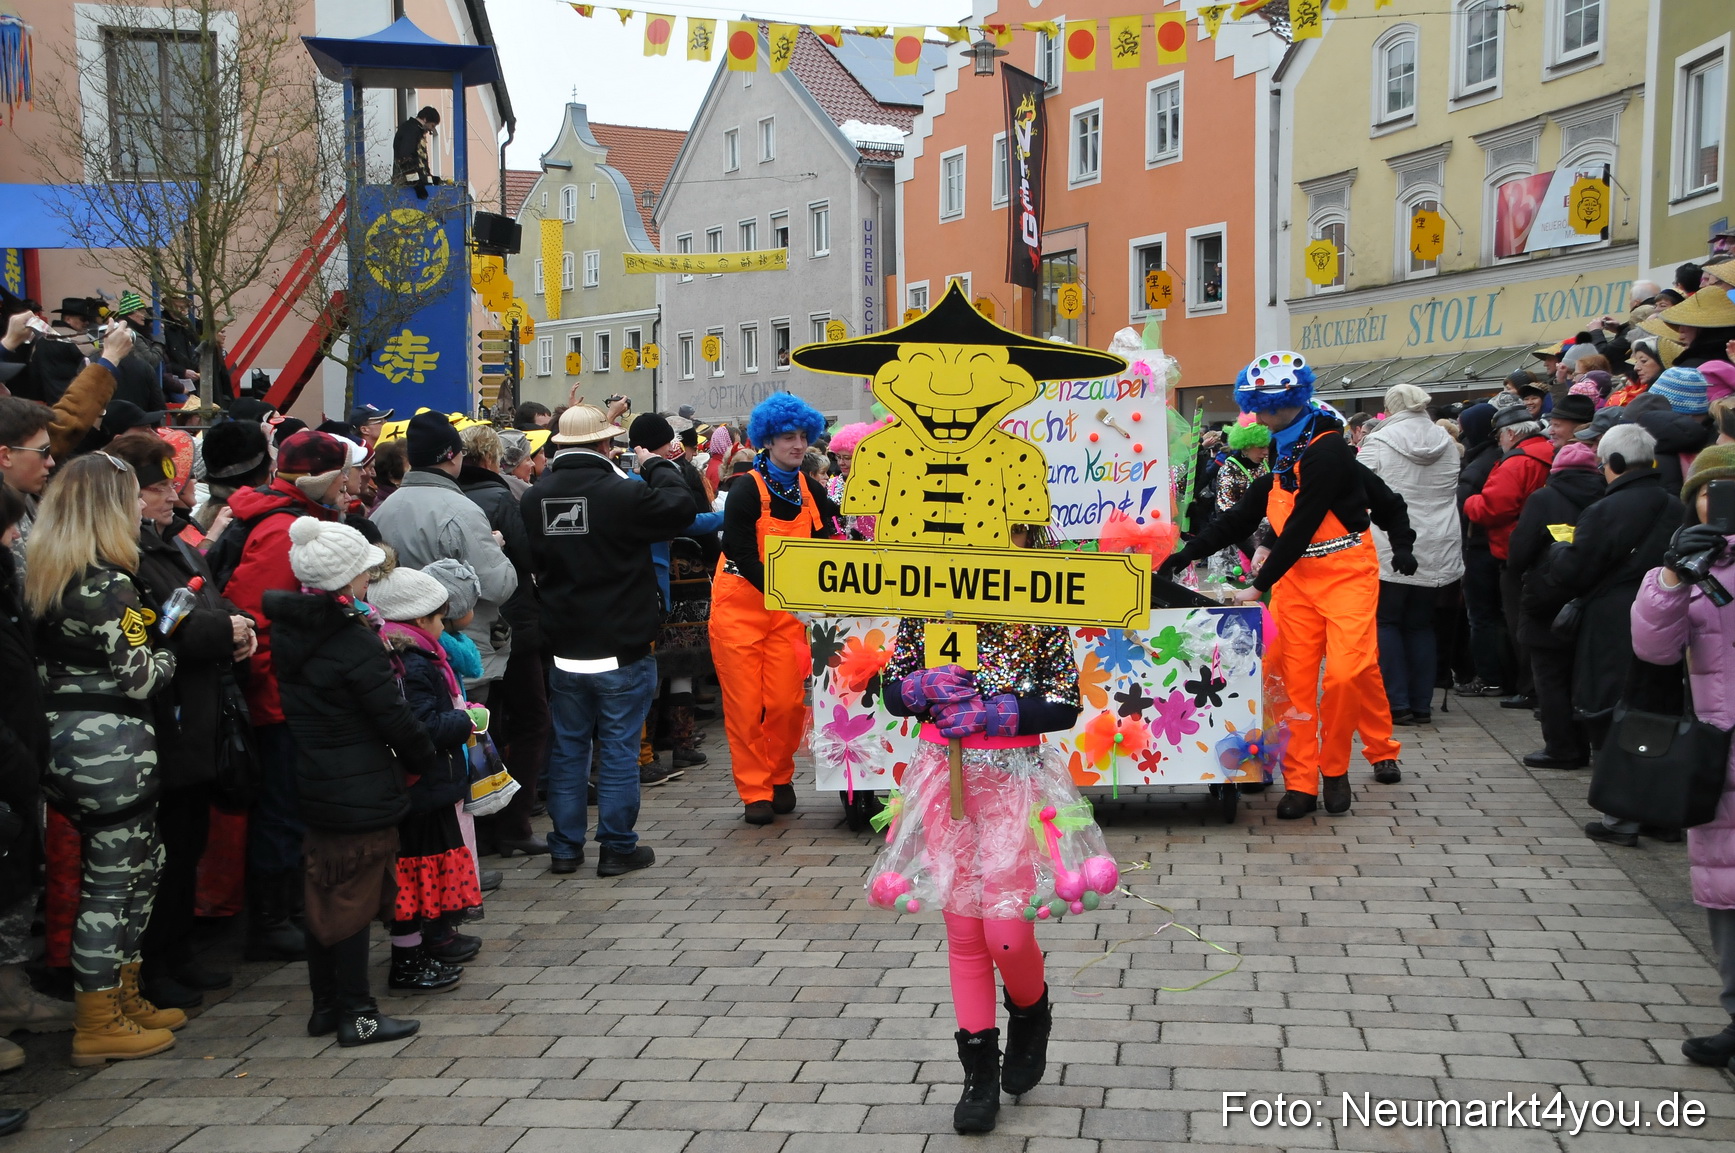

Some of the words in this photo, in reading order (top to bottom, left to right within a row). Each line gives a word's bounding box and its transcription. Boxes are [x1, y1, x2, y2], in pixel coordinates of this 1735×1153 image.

[864, 220, 873, 286] UHREN
[864, 297, 873, 335] SCH
[1301, 314, 1387, 350] BÄCKEREI
[1407, 293, 1502, 347] STOLL
[708, 383, 749, 410] OPTIK
[1084, 448, 1158, 485] Kaiser
[817, 560, 1086, 606] GAU-DI-WEI-DIE
[939, 631, 961, 663] 4
